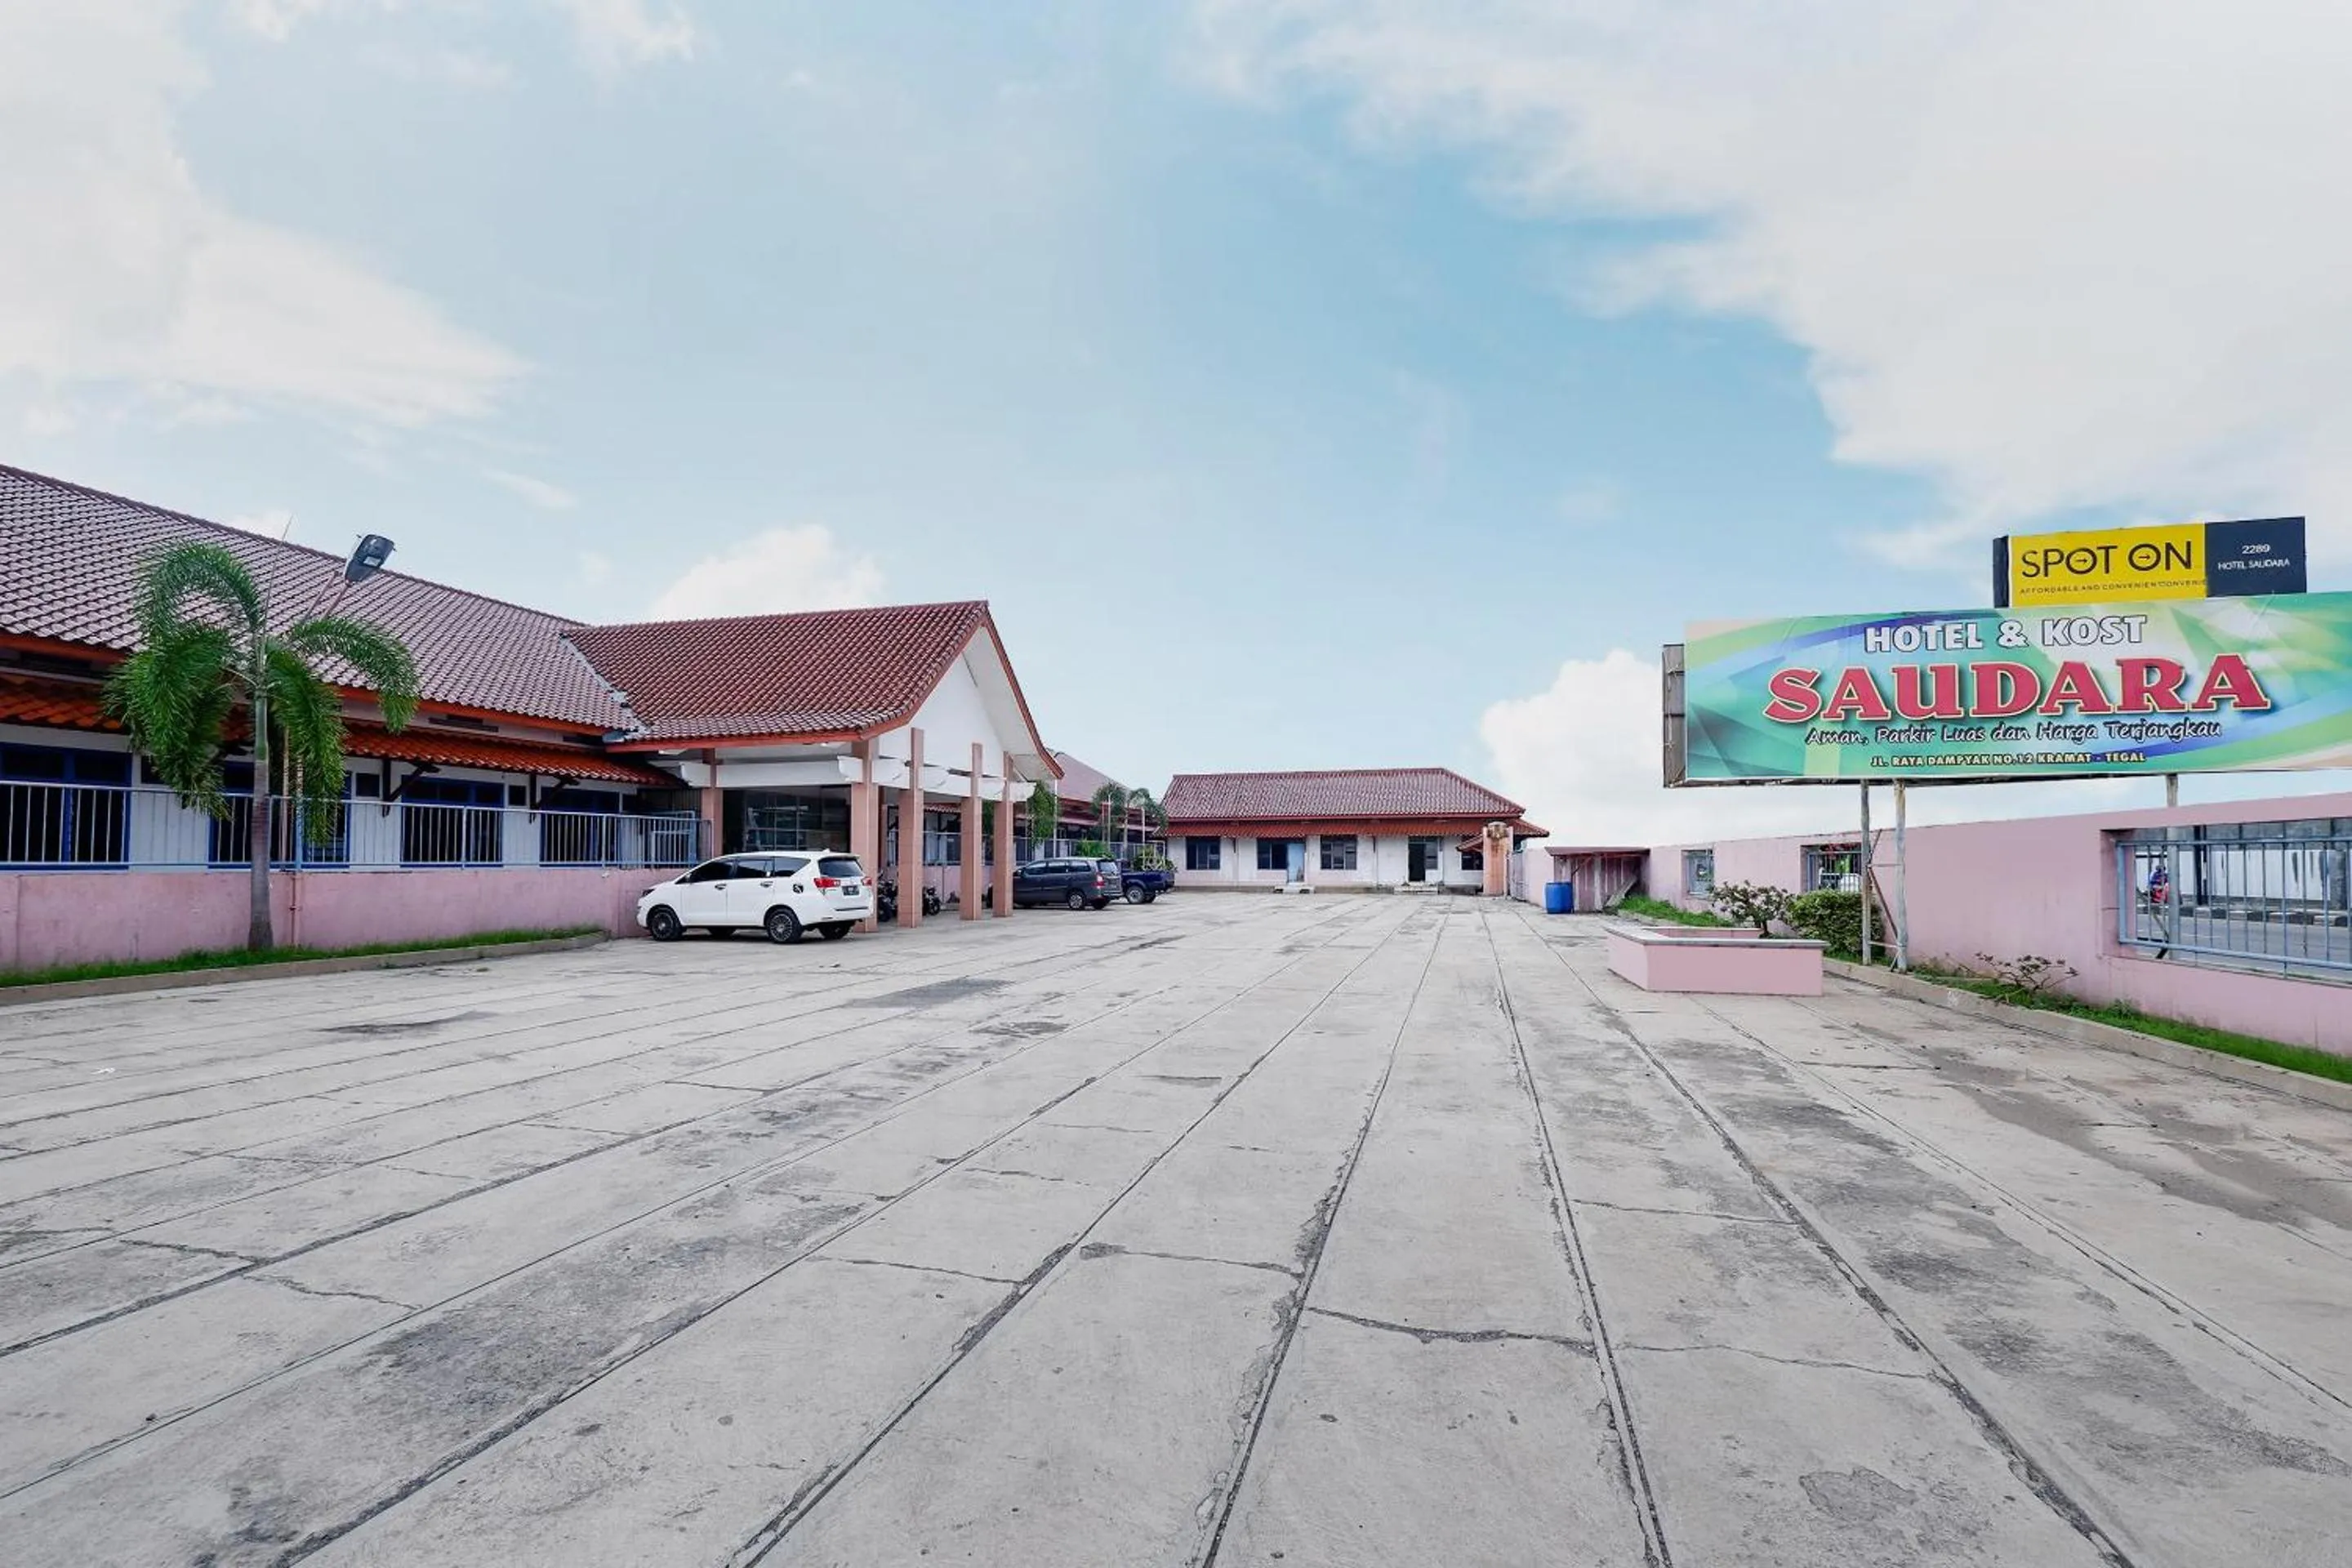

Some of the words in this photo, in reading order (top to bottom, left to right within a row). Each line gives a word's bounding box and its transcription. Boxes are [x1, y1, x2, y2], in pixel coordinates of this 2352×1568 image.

[2021, 546, 2118, 577] SPOT
[2127, 541, 2192, 571] ON
[2242, 544, 2270, 555] 2289
[2217, 560, 2247, 571] HOTEL
[2248, 557, 2290, 568] SAUDARA
[1864, 622, 1984, 653] HOTEL
[1997, 619, 2029, 648] &
[2042, 615, 2147, 647] KOST
[1762, 653, 2272, 724] SAUDARA
[1806, 727, 1869, 745] Aman,
[1875, 724, 1936, 744] Parkir
[1942, 722, 1985, 742] Luas
[1991, 721, 2031, 742] dan
[2037, 720, 2099, 745] Harga
[2103, 717, 2222, 744] Terjangkau
[1871, 755, 1889, 768] JL.
[1891, 755, 1923, 767] RAYA
[1927, 754, 1990, 766] DAMPYAK
[2036, 752, 2091, 764] KRAMAT
[2105, 751, 2146, 763] TEGAL
